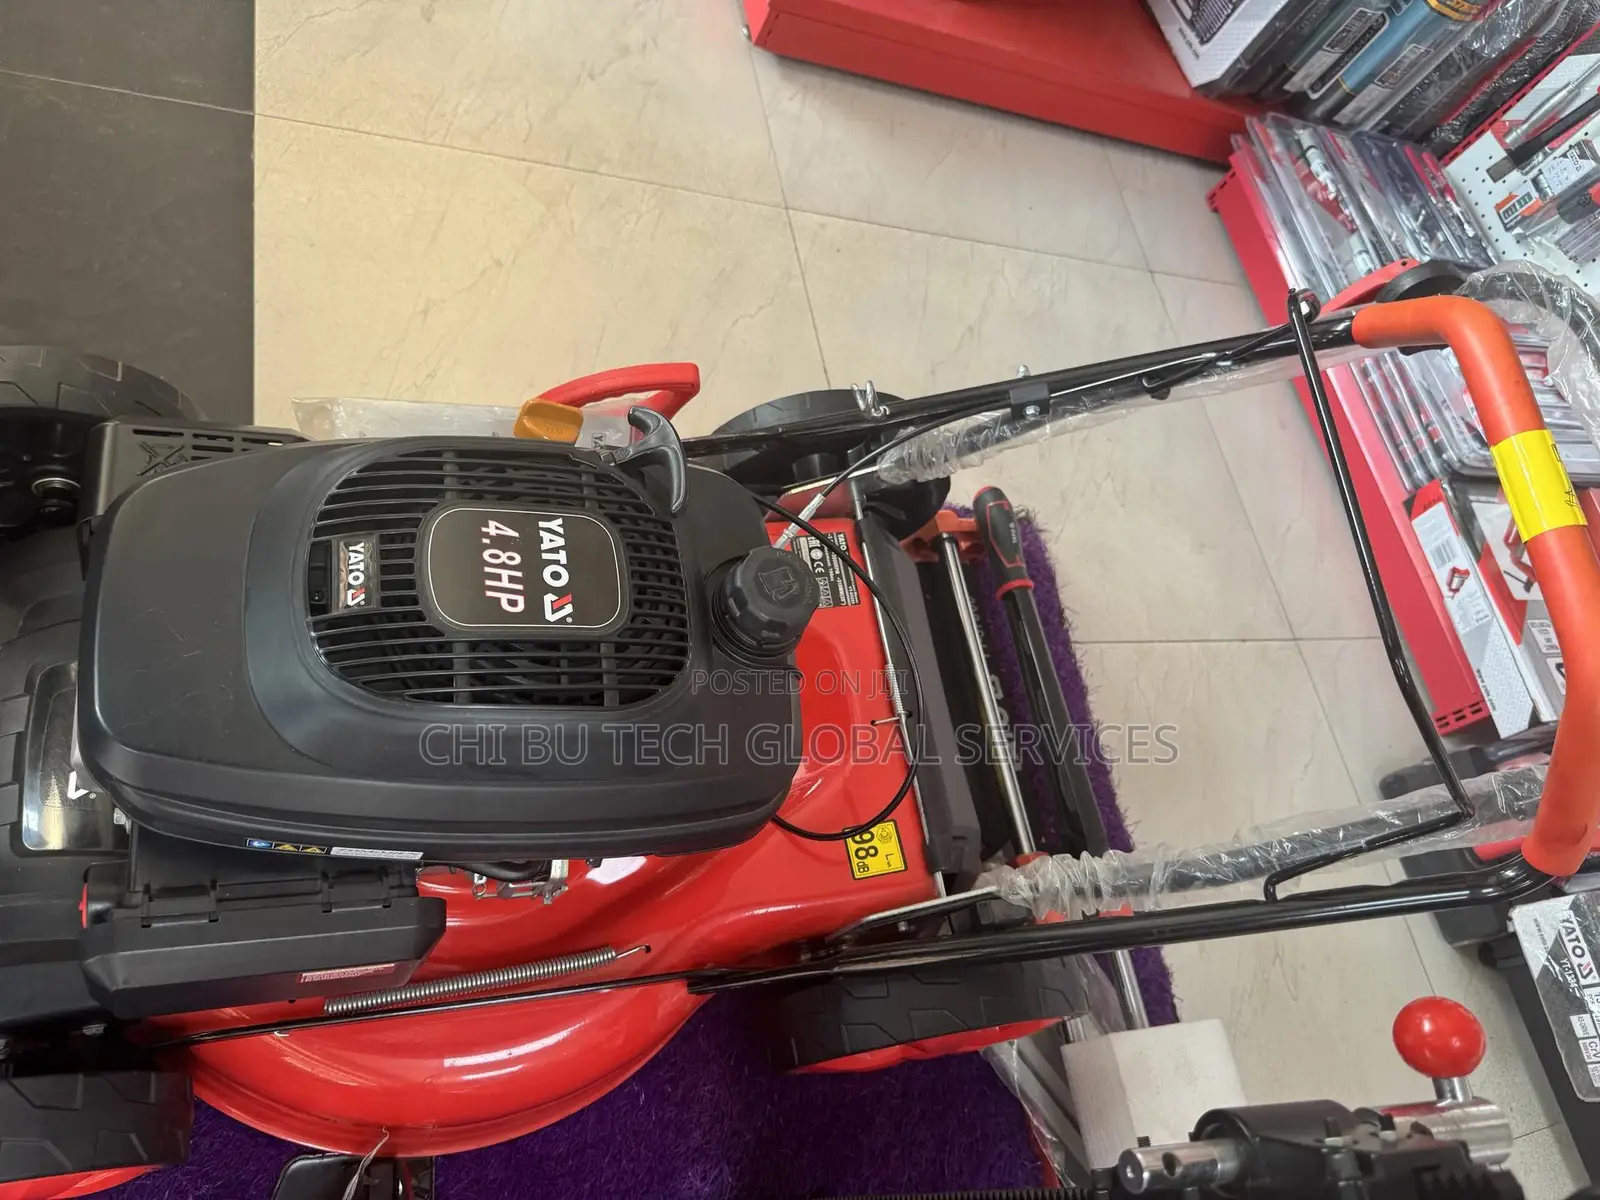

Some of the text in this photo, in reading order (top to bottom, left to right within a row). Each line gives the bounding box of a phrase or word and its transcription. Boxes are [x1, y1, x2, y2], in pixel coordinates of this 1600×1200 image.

[348, 541, 365, 586] YATO
[538, 517, 570, 588] YATO
[838, 533, 847, 551] YATO
[480, 519, 526, 613] 4.8HP
[813, 561, 826, 574] CE
[1561, 914, 1586, 959] YATO
